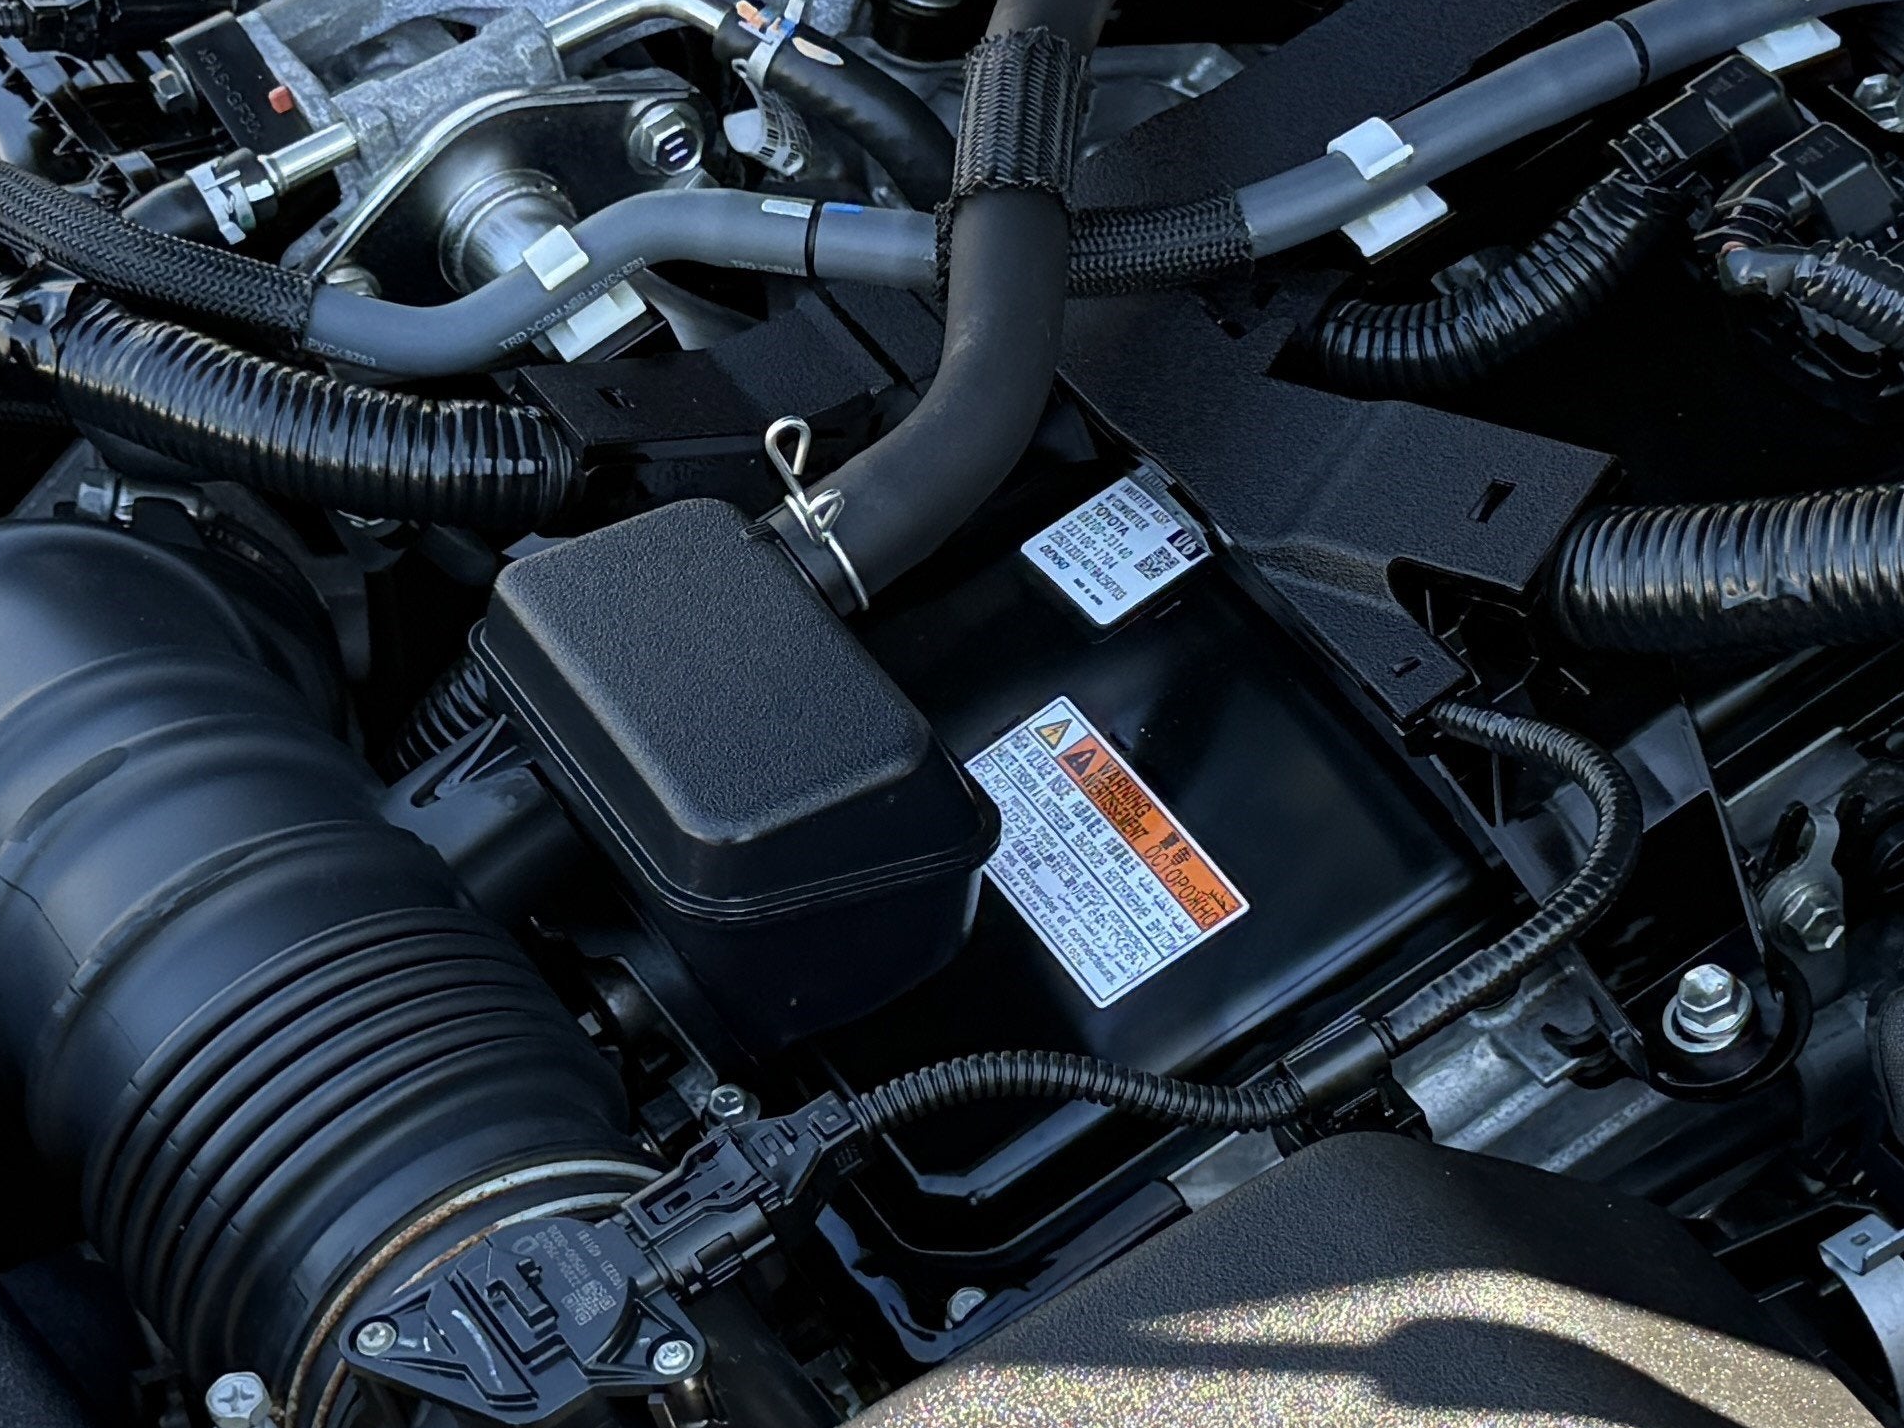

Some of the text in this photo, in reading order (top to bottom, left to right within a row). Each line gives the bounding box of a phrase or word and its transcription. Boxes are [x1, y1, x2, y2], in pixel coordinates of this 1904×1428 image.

[1090, 501, 1130, 537] TOYOTA
[1078, 769, 1149, 843] AVERTISSEMENT
[1099, 759, 1153, 819] WARNING
[1142, 842, 1220, 928] ОСТОРОЖНО
